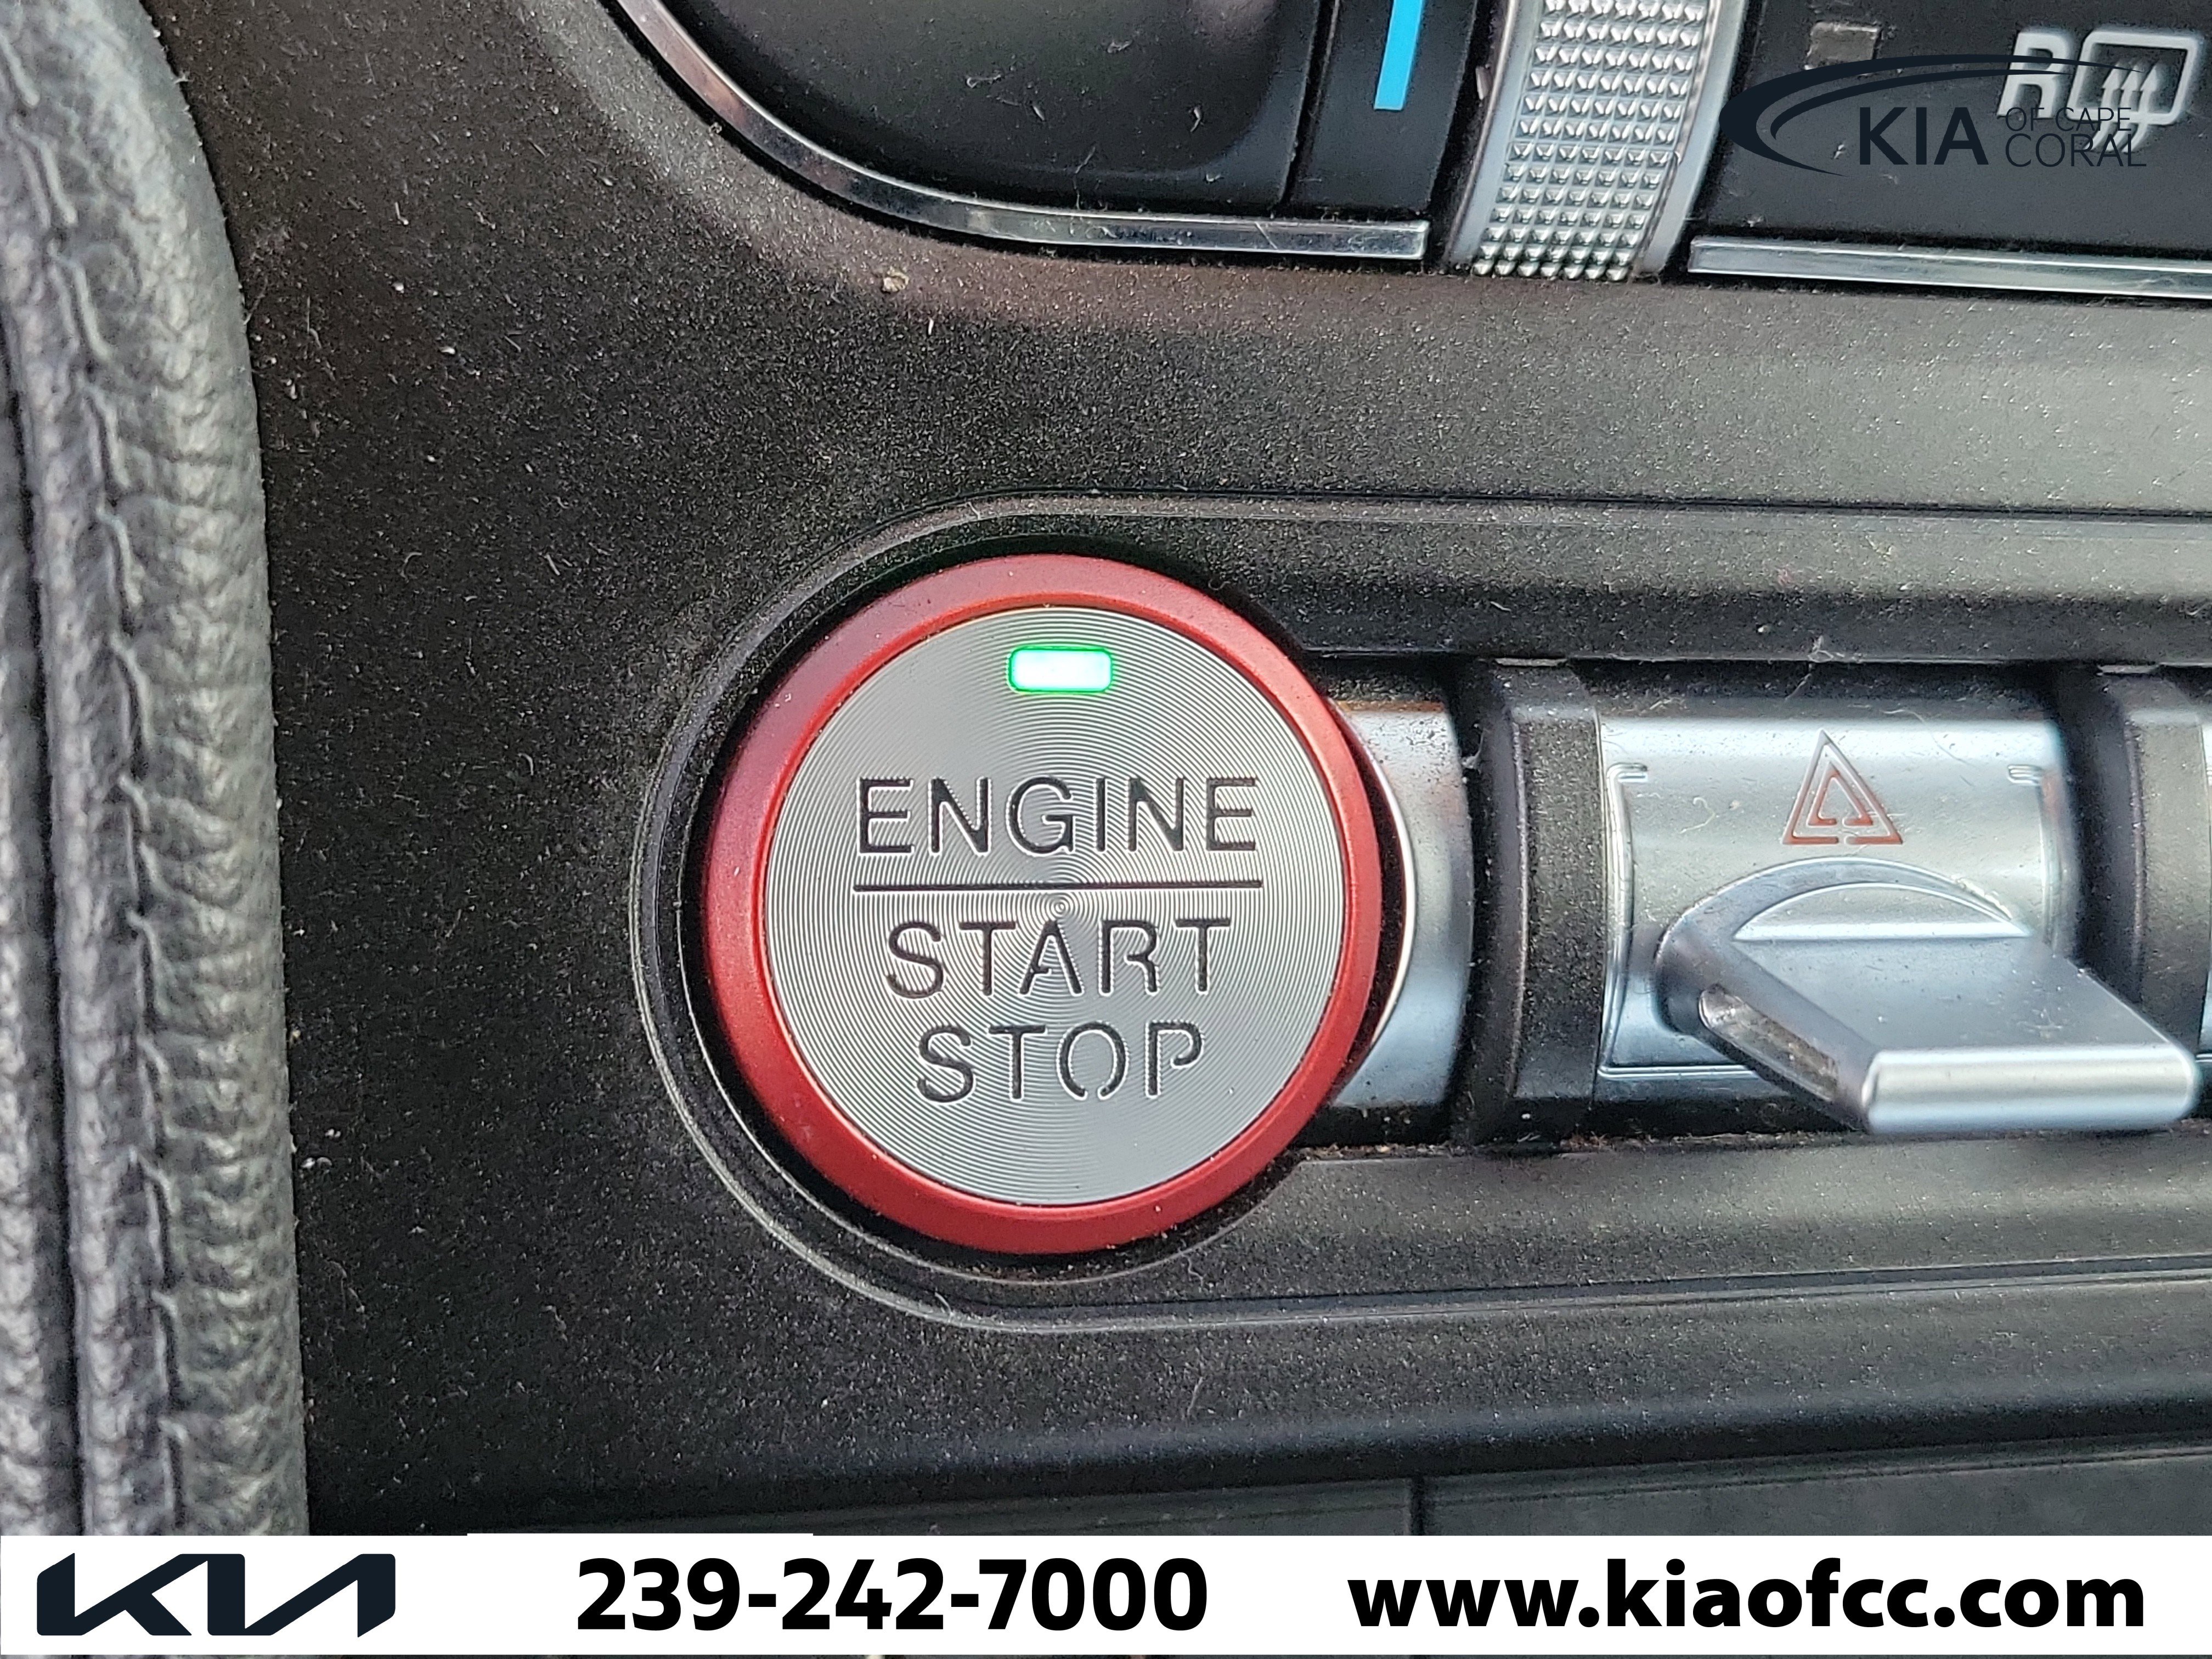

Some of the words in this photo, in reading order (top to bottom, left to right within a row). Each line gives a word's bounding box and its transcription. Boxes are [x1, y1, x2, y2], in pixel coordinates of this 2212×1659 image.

[857, 777, 1257, 854] ENGINE
[886, 918, 1232, 998] START
[916, 1020, 1204, 1103] STOP
